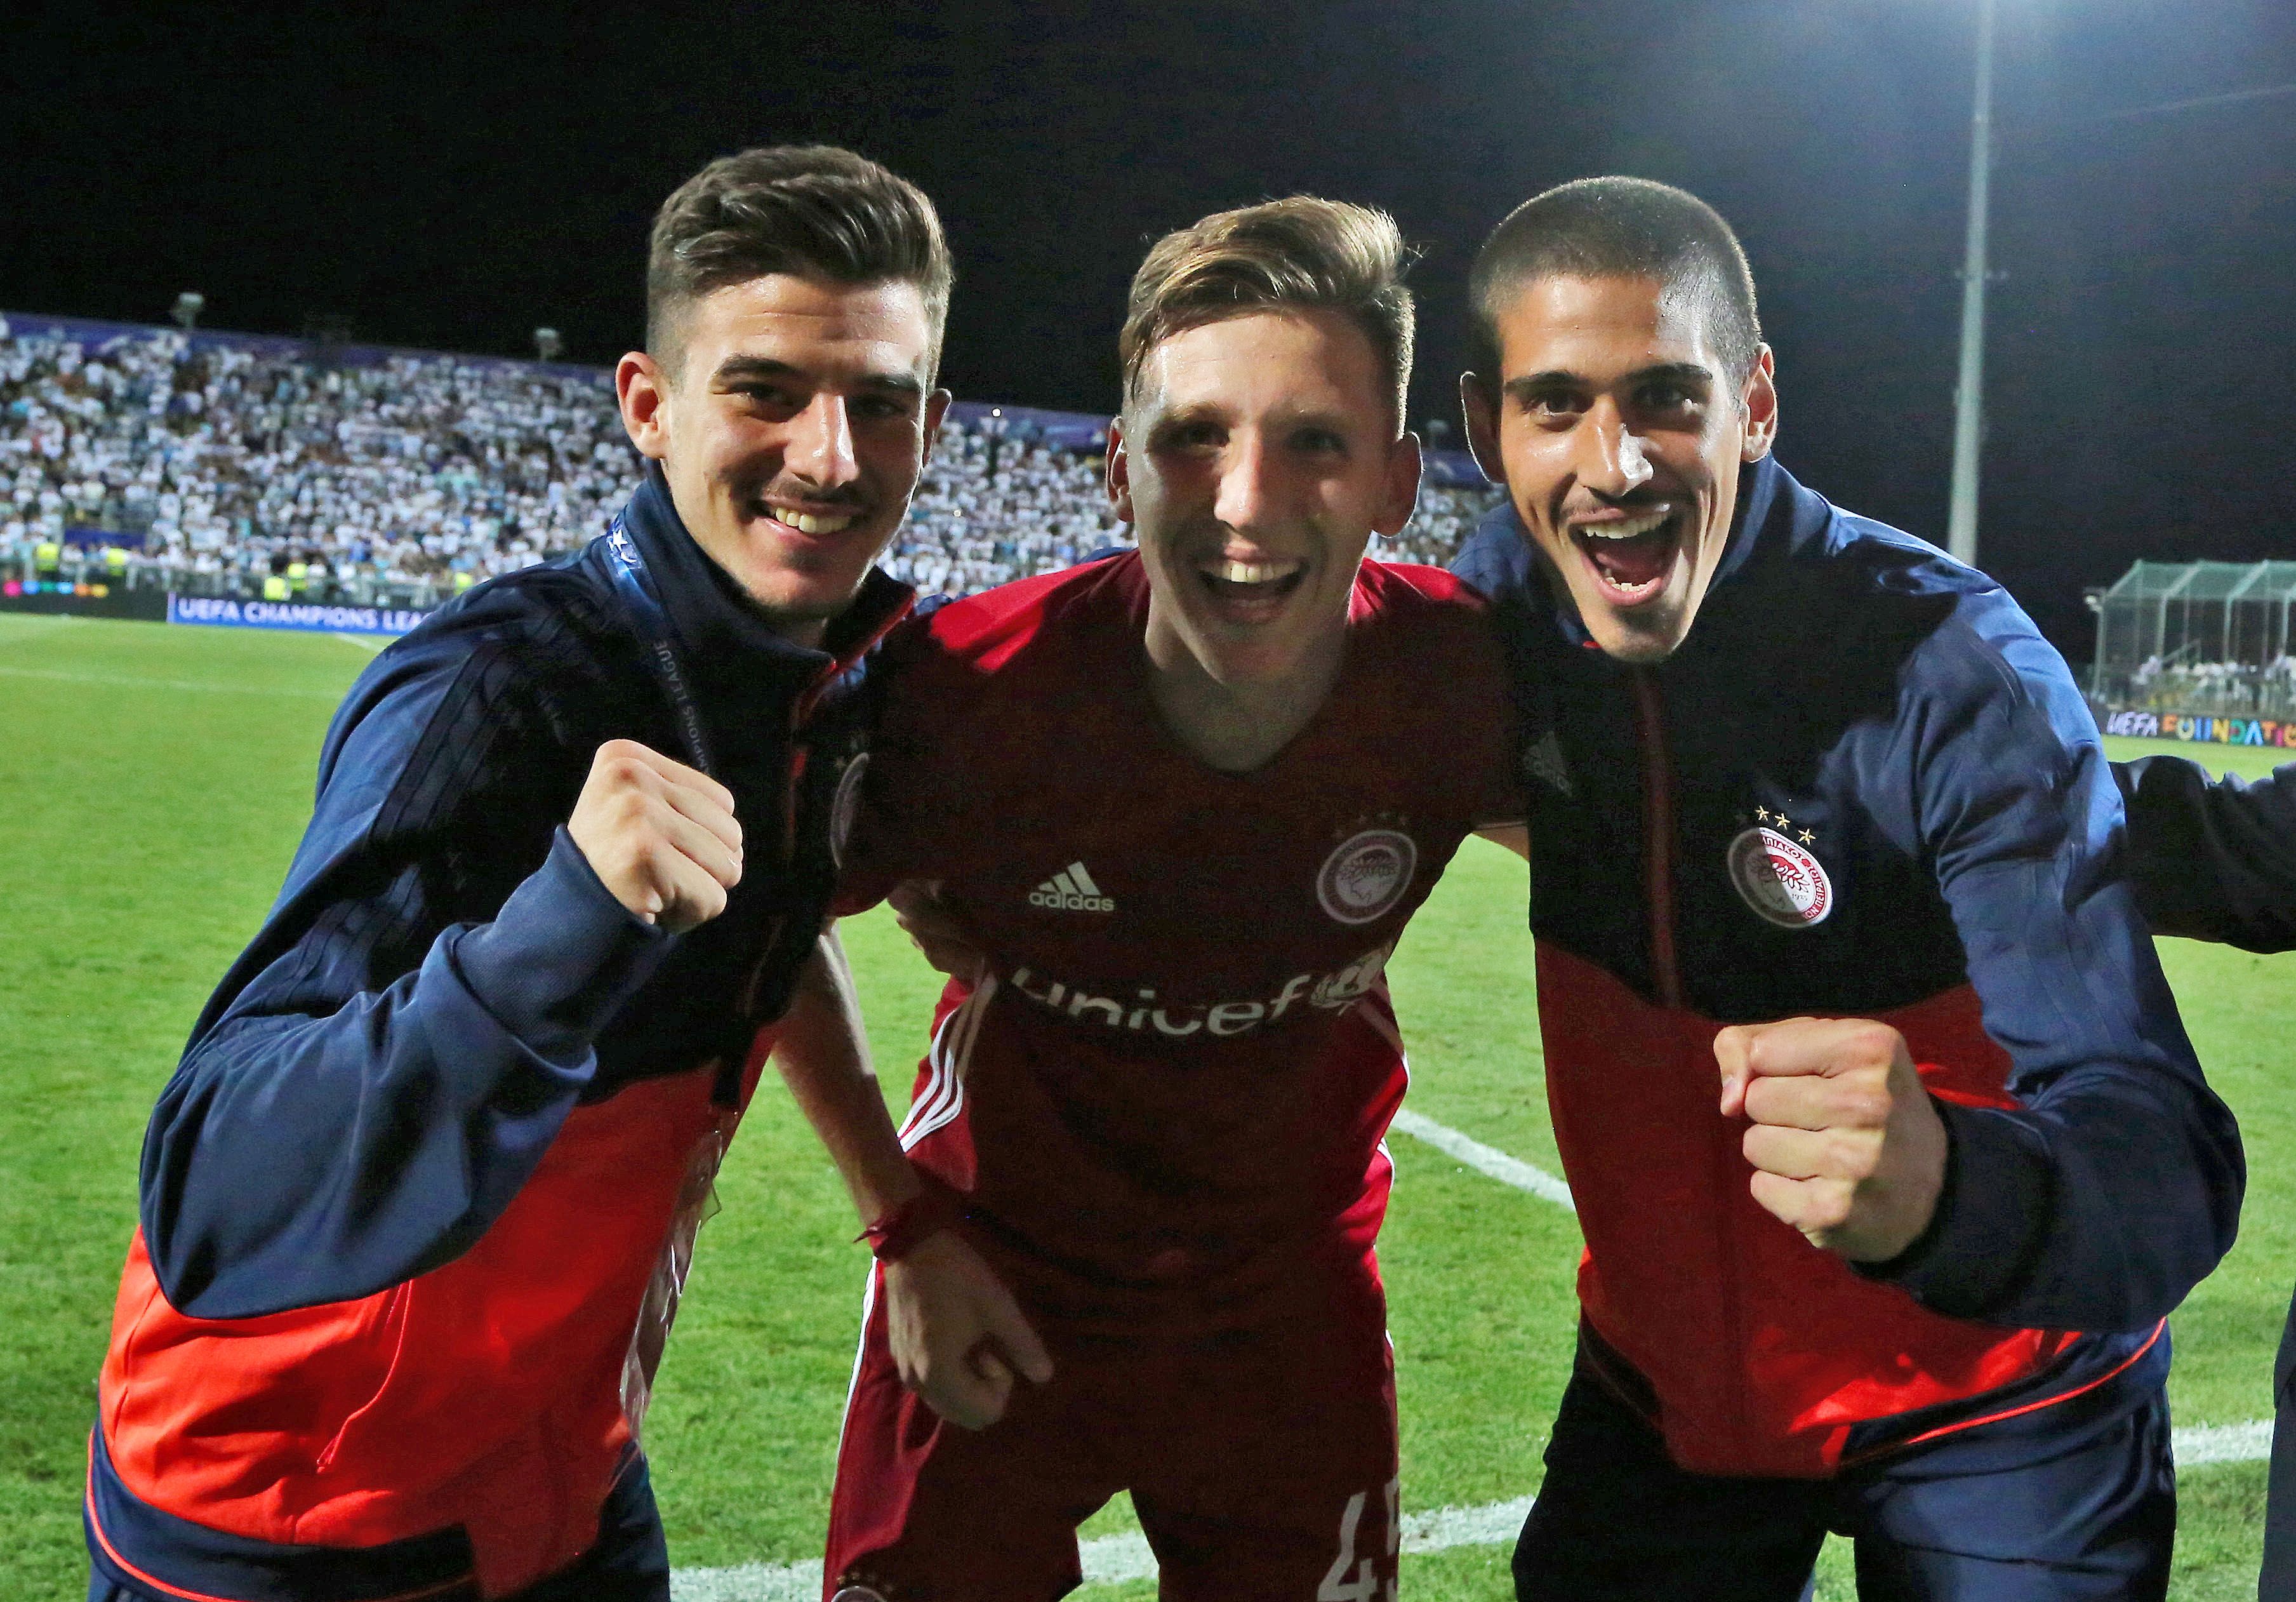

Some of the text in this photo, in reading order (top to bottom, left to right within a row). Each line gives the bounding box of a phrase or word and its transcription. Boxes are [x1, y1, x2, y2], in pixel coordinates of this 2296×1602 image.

[178, 597, 241, 620] UEFA
[244, 601, 378, 629] CHAMPIONS
[2106, 711, 2158, 737] UEFA
[1028, 891, 1115, 912] adidas
[1011, 966, 1311, 1036] unicef
